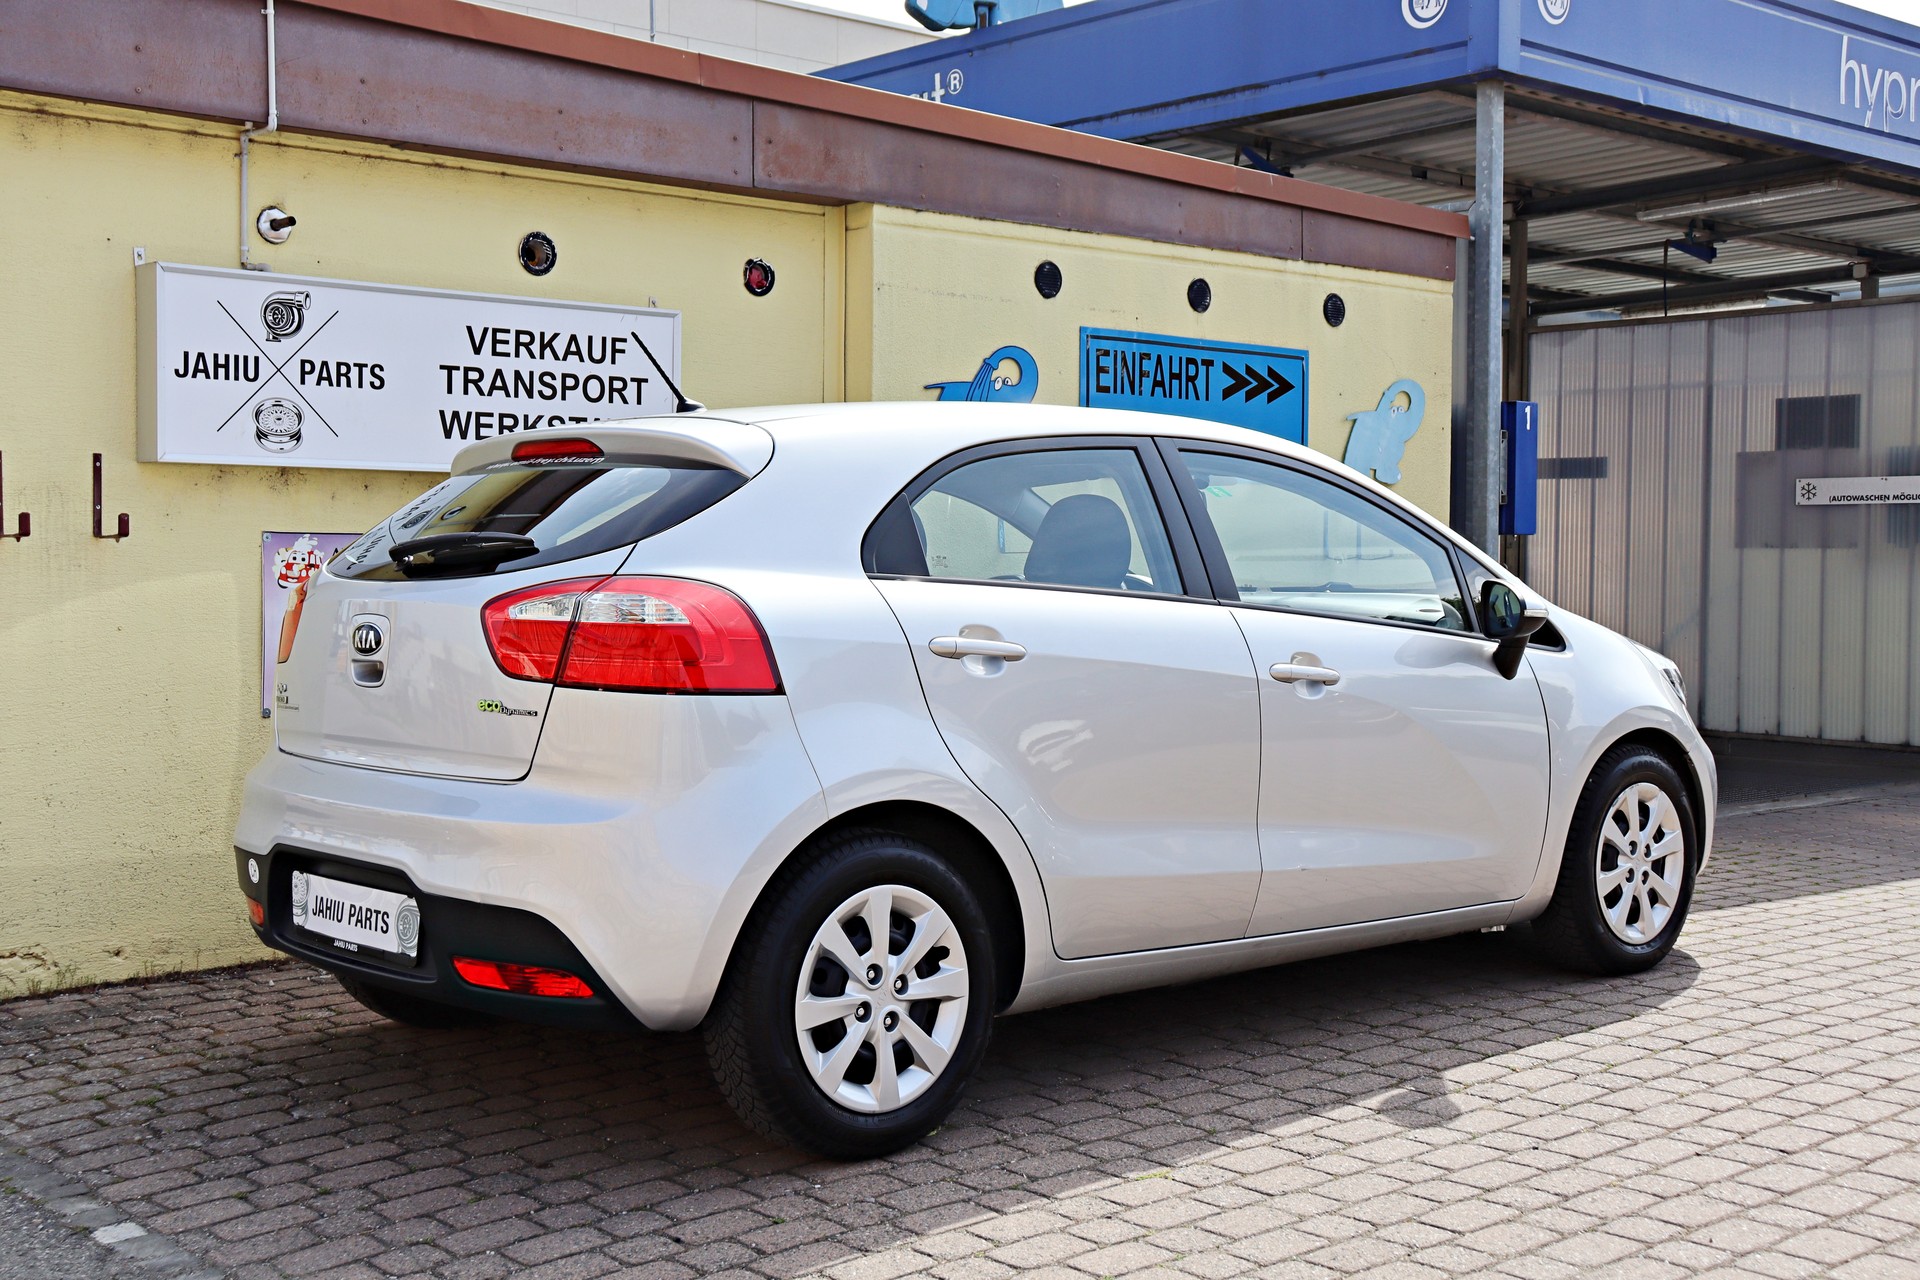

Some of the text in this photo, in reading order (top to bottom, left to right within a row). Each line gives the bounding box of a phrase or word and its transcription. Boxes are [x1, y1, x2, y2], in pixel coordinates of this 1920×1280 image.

[466, 325, 628, 366] VERKAUF
[174, 351, 385, 390] JAHIU PARTS
[439, 364, 649, 405] TRANSPORT
[1095, 348, 1214, 401] EINFAHRT
[439, 409, 600, 441] WERK
[1525, 405, 1530, 430] 1
[354, 629, 377, 649] KIA
[312, 895, 390, 935] JAHIU PARTS
